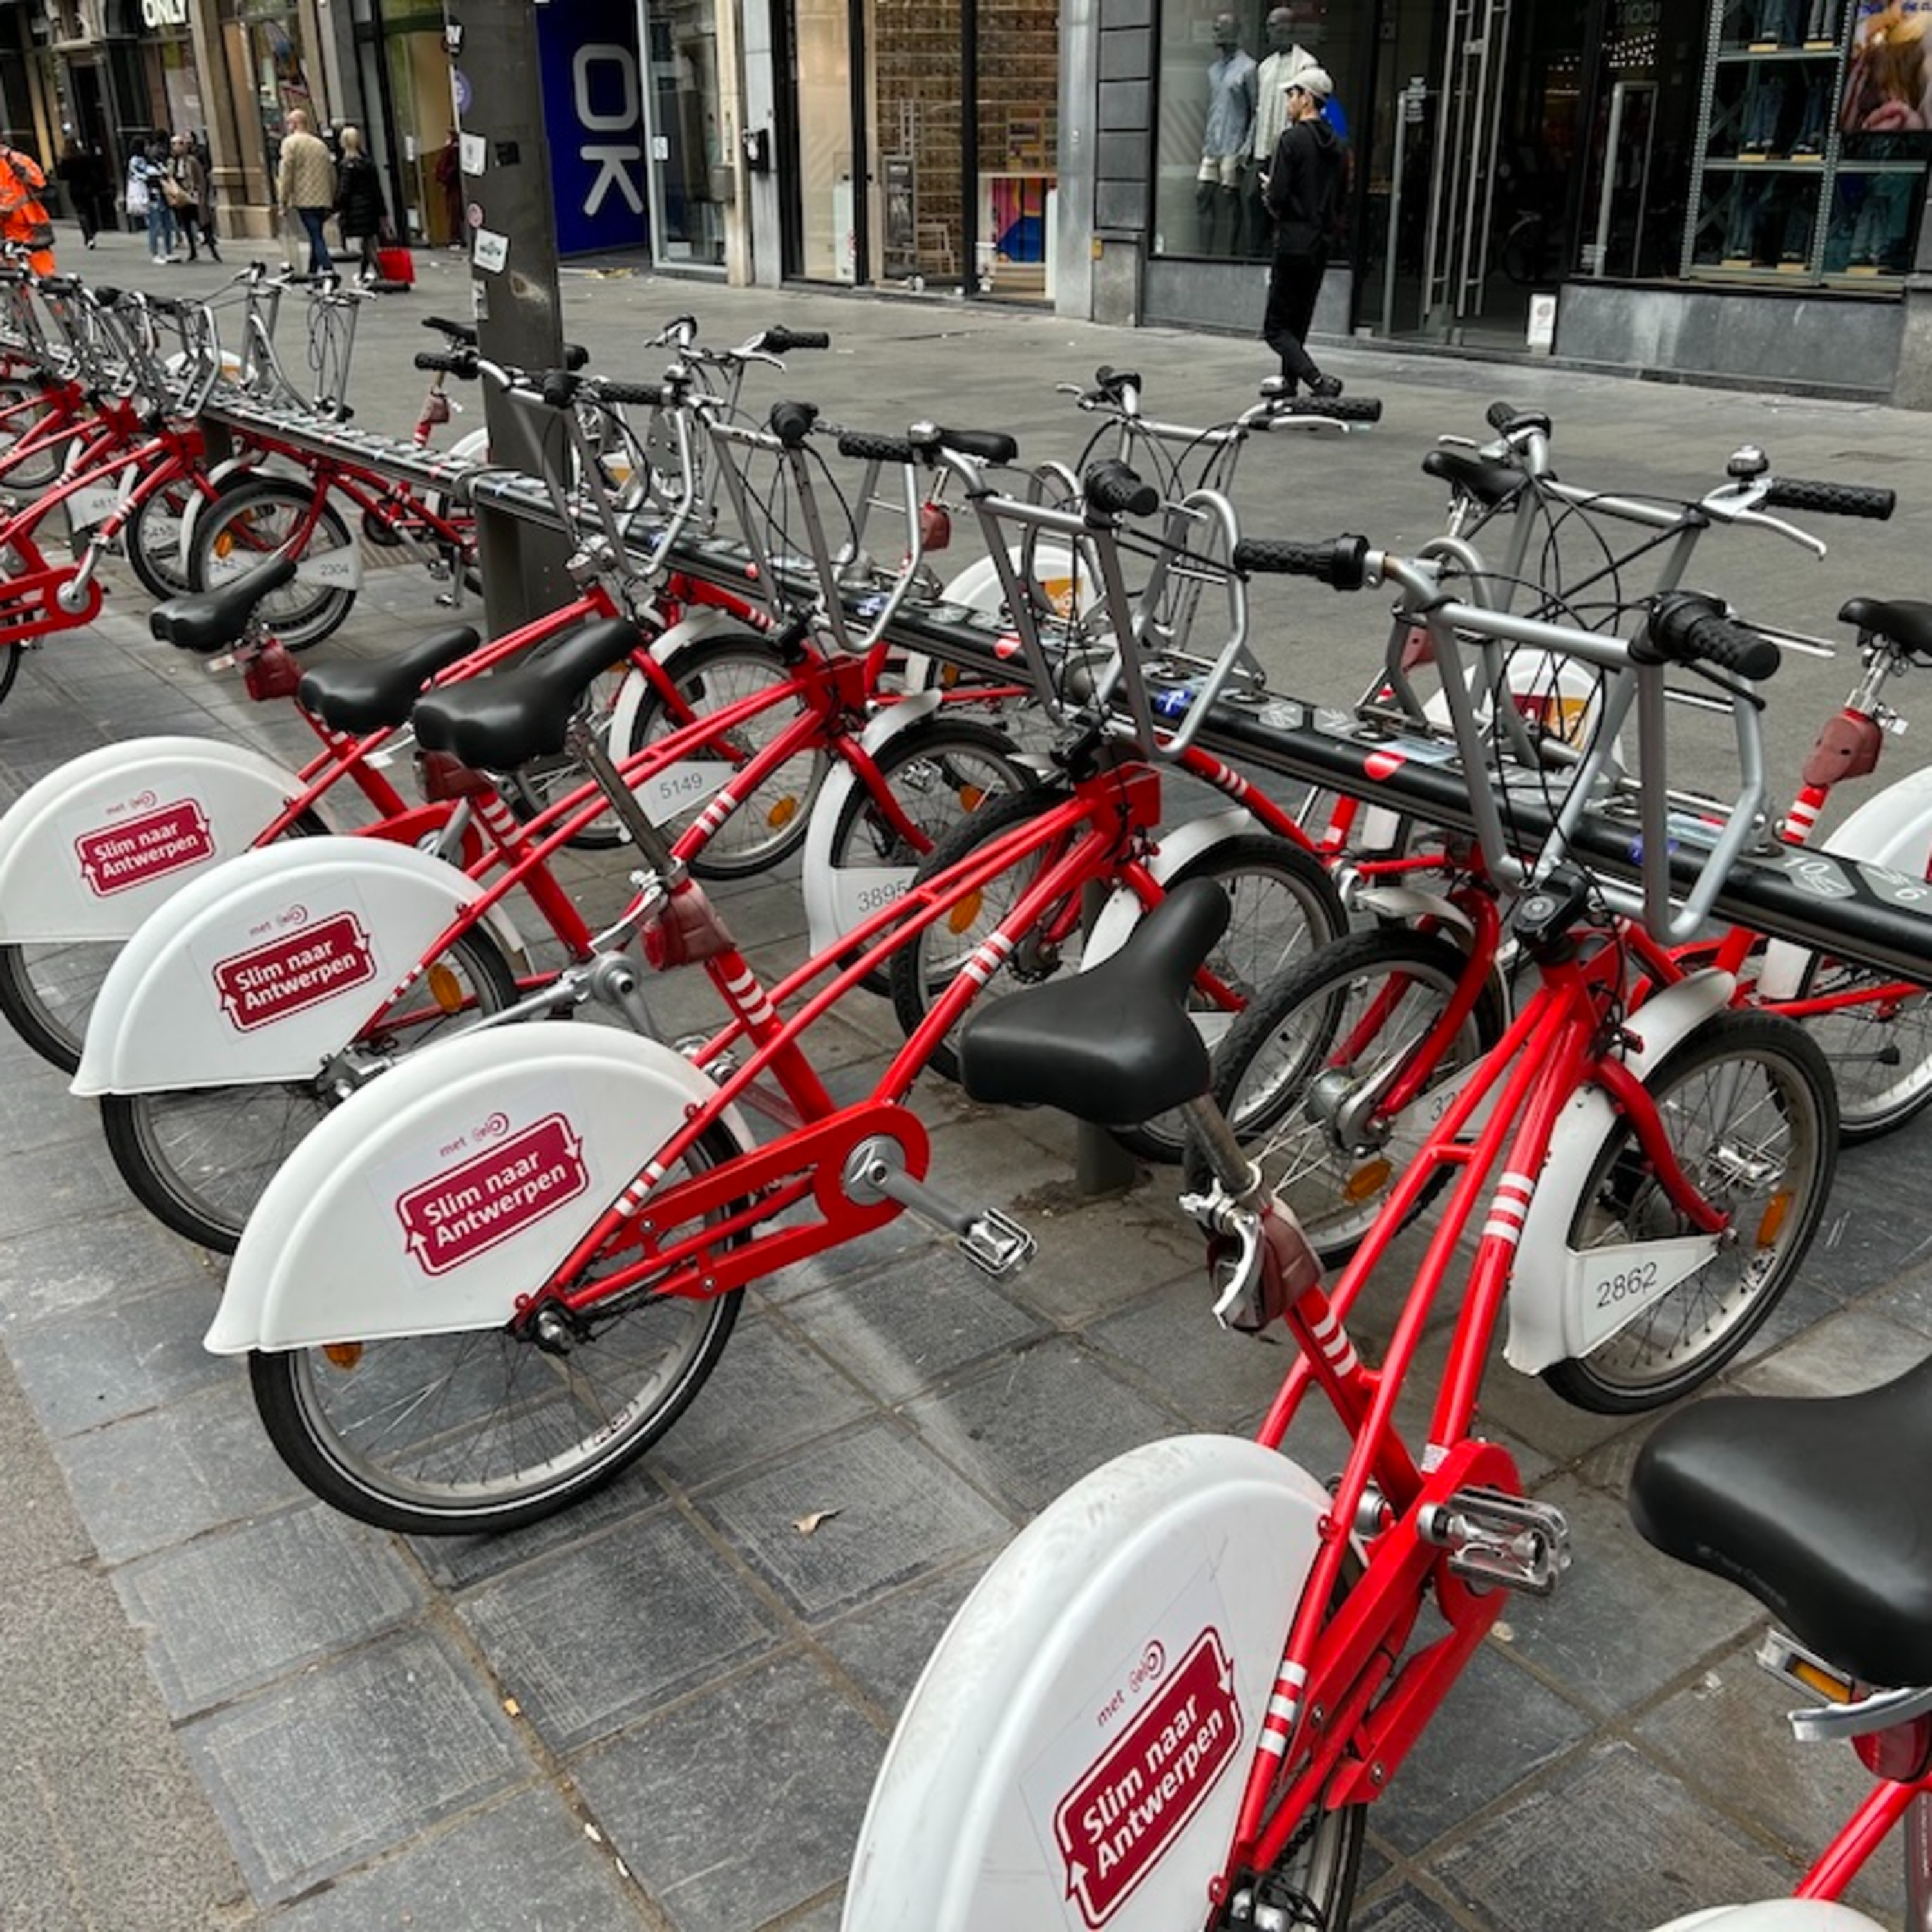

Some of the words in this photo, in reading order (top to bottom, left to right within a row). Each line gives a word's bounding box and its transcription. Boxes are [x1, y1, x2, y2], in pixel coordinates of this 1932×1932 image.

[572, 43, 643, 216] OK
[659, 772, 703, 799] 5149
[93, 838, 137, 862] Slim
[138, 821, 178, 847] naar
[101, 833, 200, 879] Antwerpen
[1783, 857, 1830, 875] 10
[857, 880, 907, 913] 3895
[249, 921, 272, 938] met
[234, 962, 284, 992] Slim
[285, 940, 334, 971] naar
[245, 952, 357, 1011] Antwerpen
[440, 1135, 468, 1157] met
[423, 1185, 482, 1226] Slim
[485, 1151, 541, 1194] naar
[435, 1163, 568, 1248] Antwerpen
[1596, 1261, 1658, 1309] 2862
[1097, 1689, 1126, 1727] met
[1082, 1766, 1144, 1844] Slim
[1144, 1694, 1200, 1774] naar
[1094, 1708, 1225, 1880] Antwerpen
